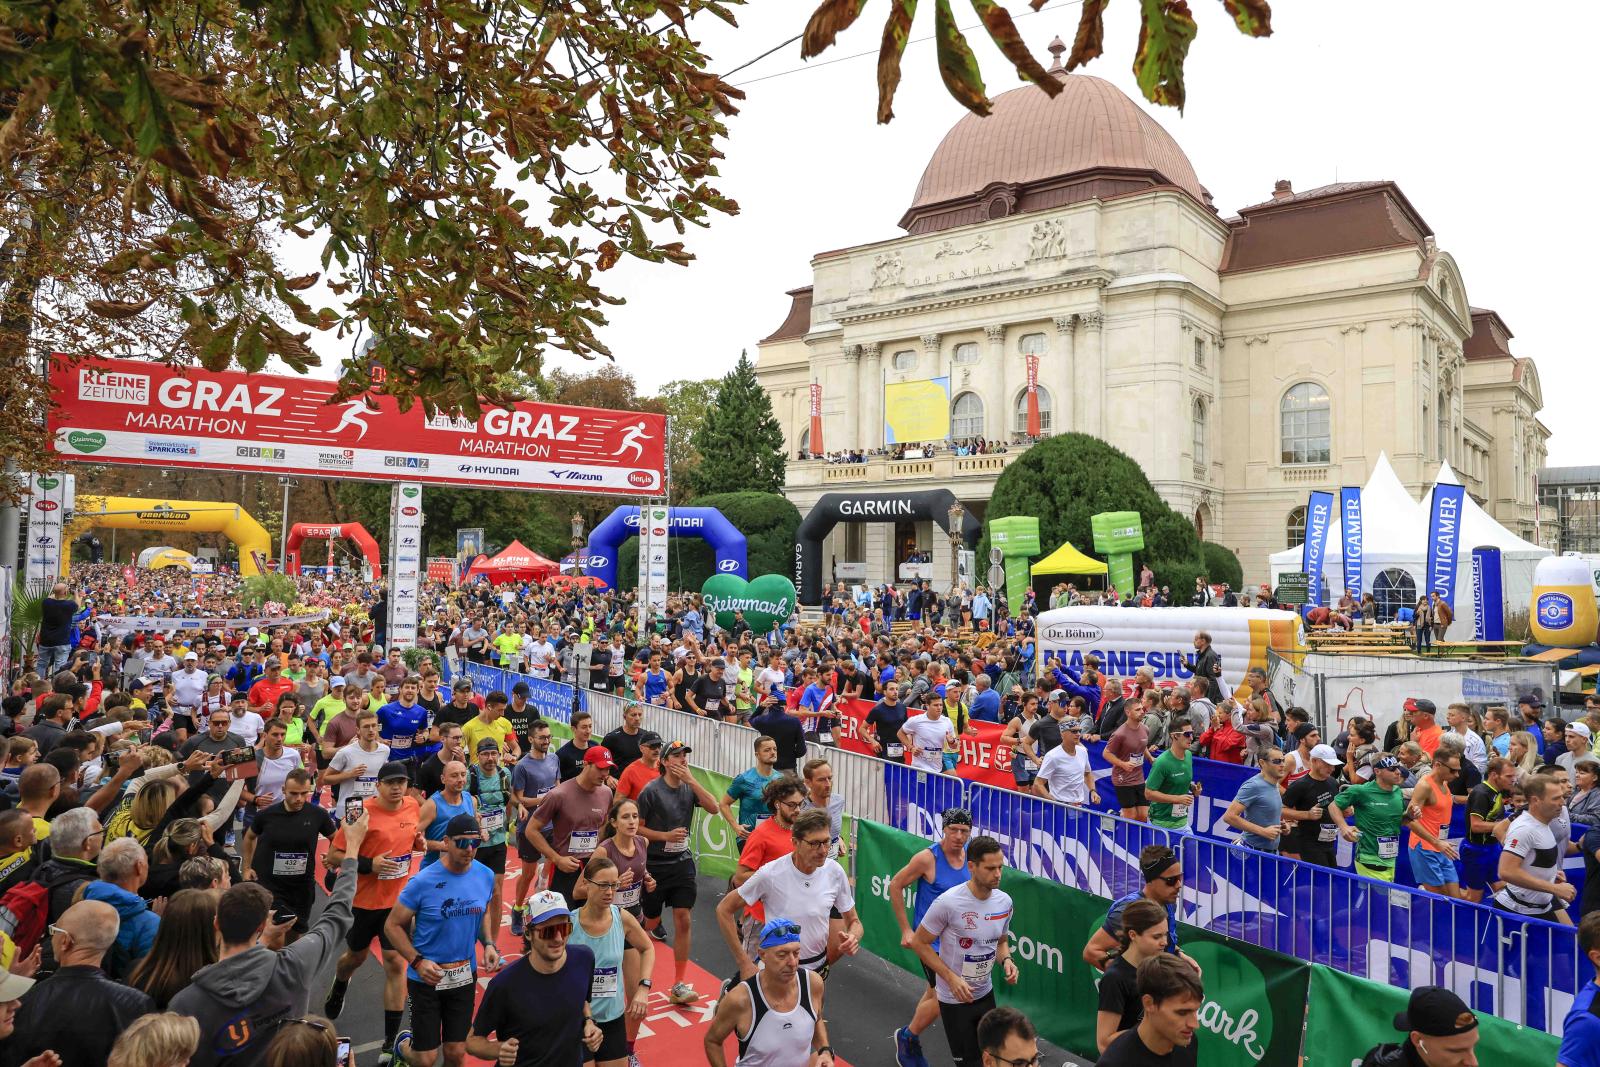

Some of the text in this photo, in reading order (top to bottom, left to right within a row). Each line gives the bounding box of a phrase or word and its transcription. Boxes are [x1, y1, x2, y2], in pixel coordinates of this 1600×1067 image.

[913, 261, 1018, 285] OPERNHAUS
[82, 373, 146, 391] KLEINE
[82, 385, 146, 402] ZEITUNG
[158, 377, 285, 417] GRAZ
[125, 410, 246, 435] MARATHON
[484, 408, 580, 442] GRAZ
[148, 446, 188, 454] SPARKASSE
[236, 446, 286, 459] GRAZ
[318, 452, 343, 460] WIENER
[459, 438, 550, 459] MARATHON
[384, 455, 430, 469] GRAZ
[474, 465, 520, 476] HYUNDAI
[630, 474, 653, 485] Hervis
[306, 528, 331, 536] SPAR
[795, 543, 803, 595] GARMIN
[702, 593, 789, 618] Steiermark
[1472, 558, 1484, 640] PUNTIGAMER
[1048, 628, 1064, 639] Dr.
[1043, 649, 1220, 680] MAGNESIU
[444, 967, 465, 978] 7061A
[976, 962, 989, 970] 365
